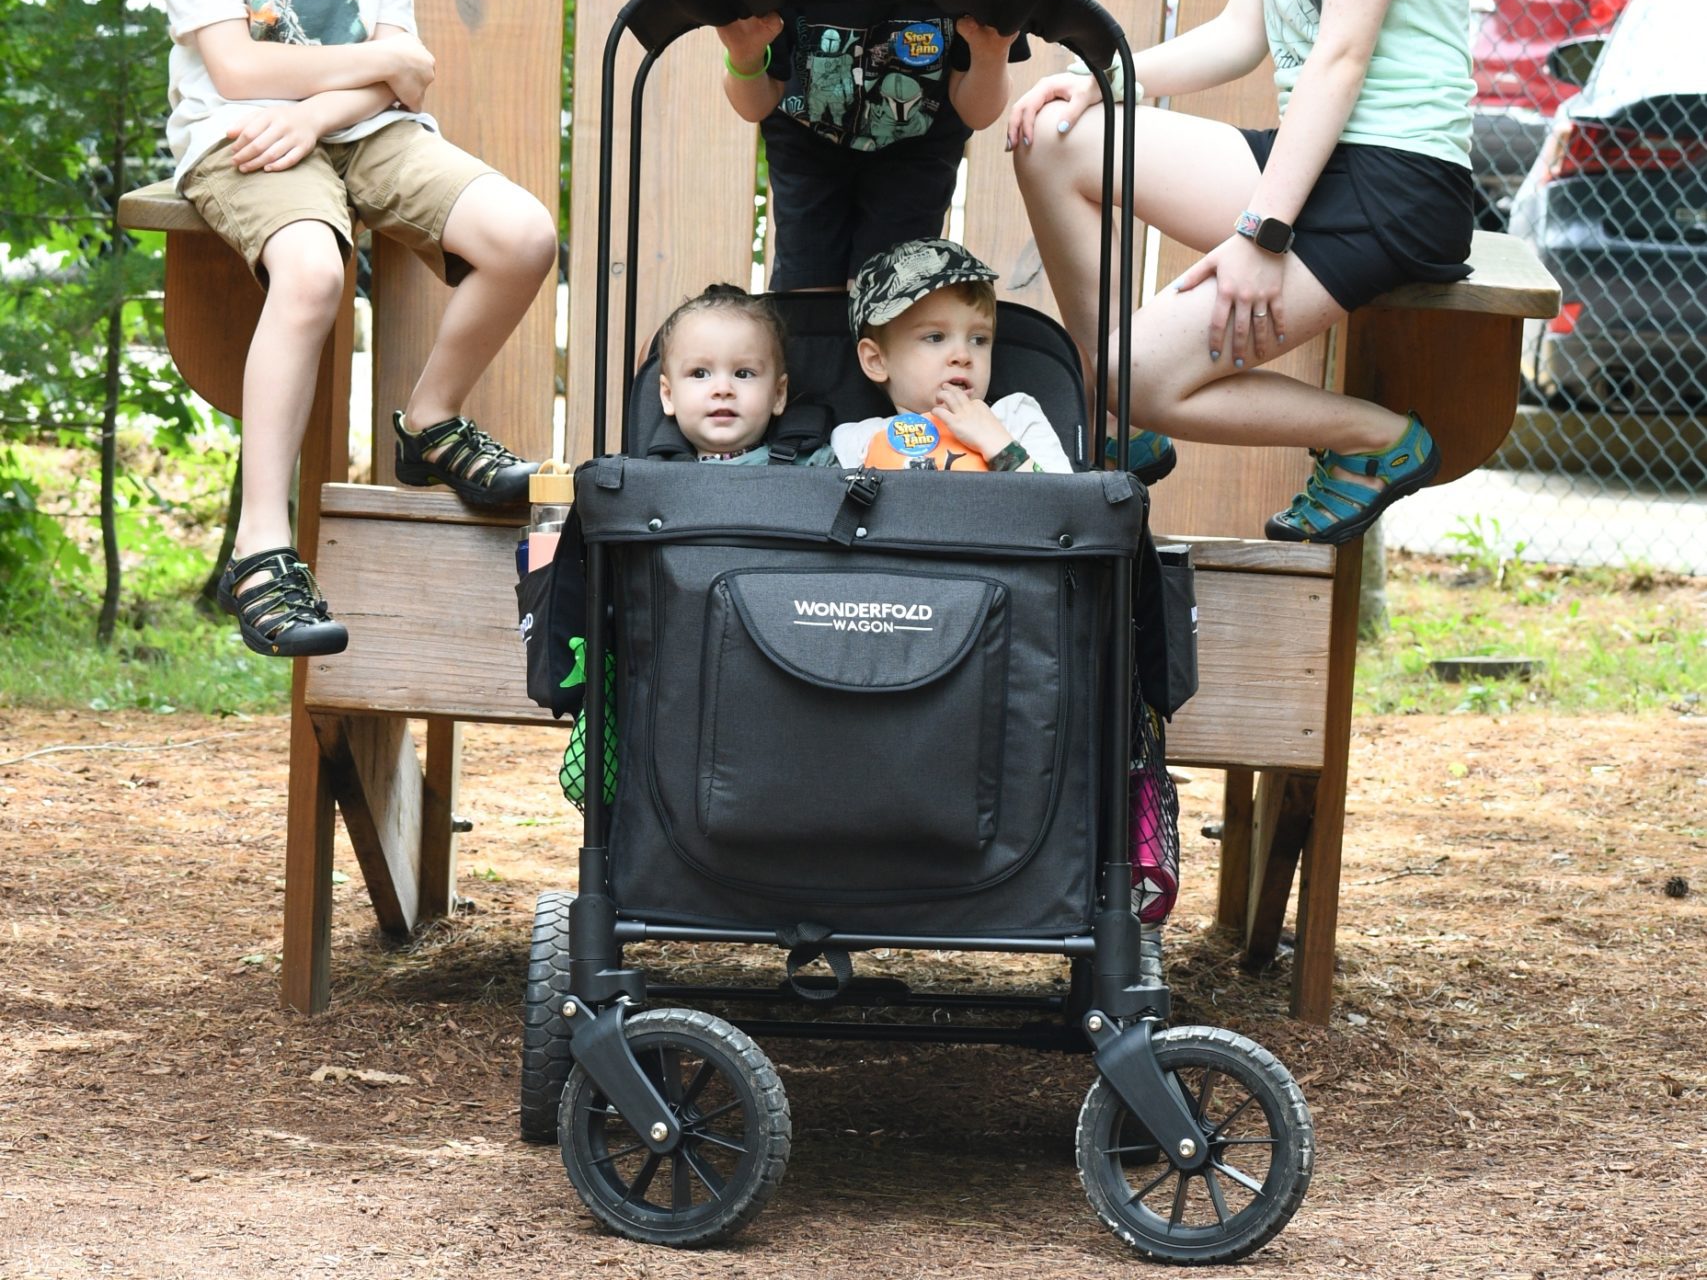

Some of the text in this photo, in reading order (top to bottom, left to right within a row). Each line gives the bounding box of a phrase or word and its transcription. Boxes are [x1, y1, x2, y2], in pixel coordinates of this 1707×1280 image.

[904, 31, 935, 46] Story
[893, 422, 927, 437] Story
[794, 600, 933, 620] WONDERFOLD
[832, 619, 894, 633] WAGON
